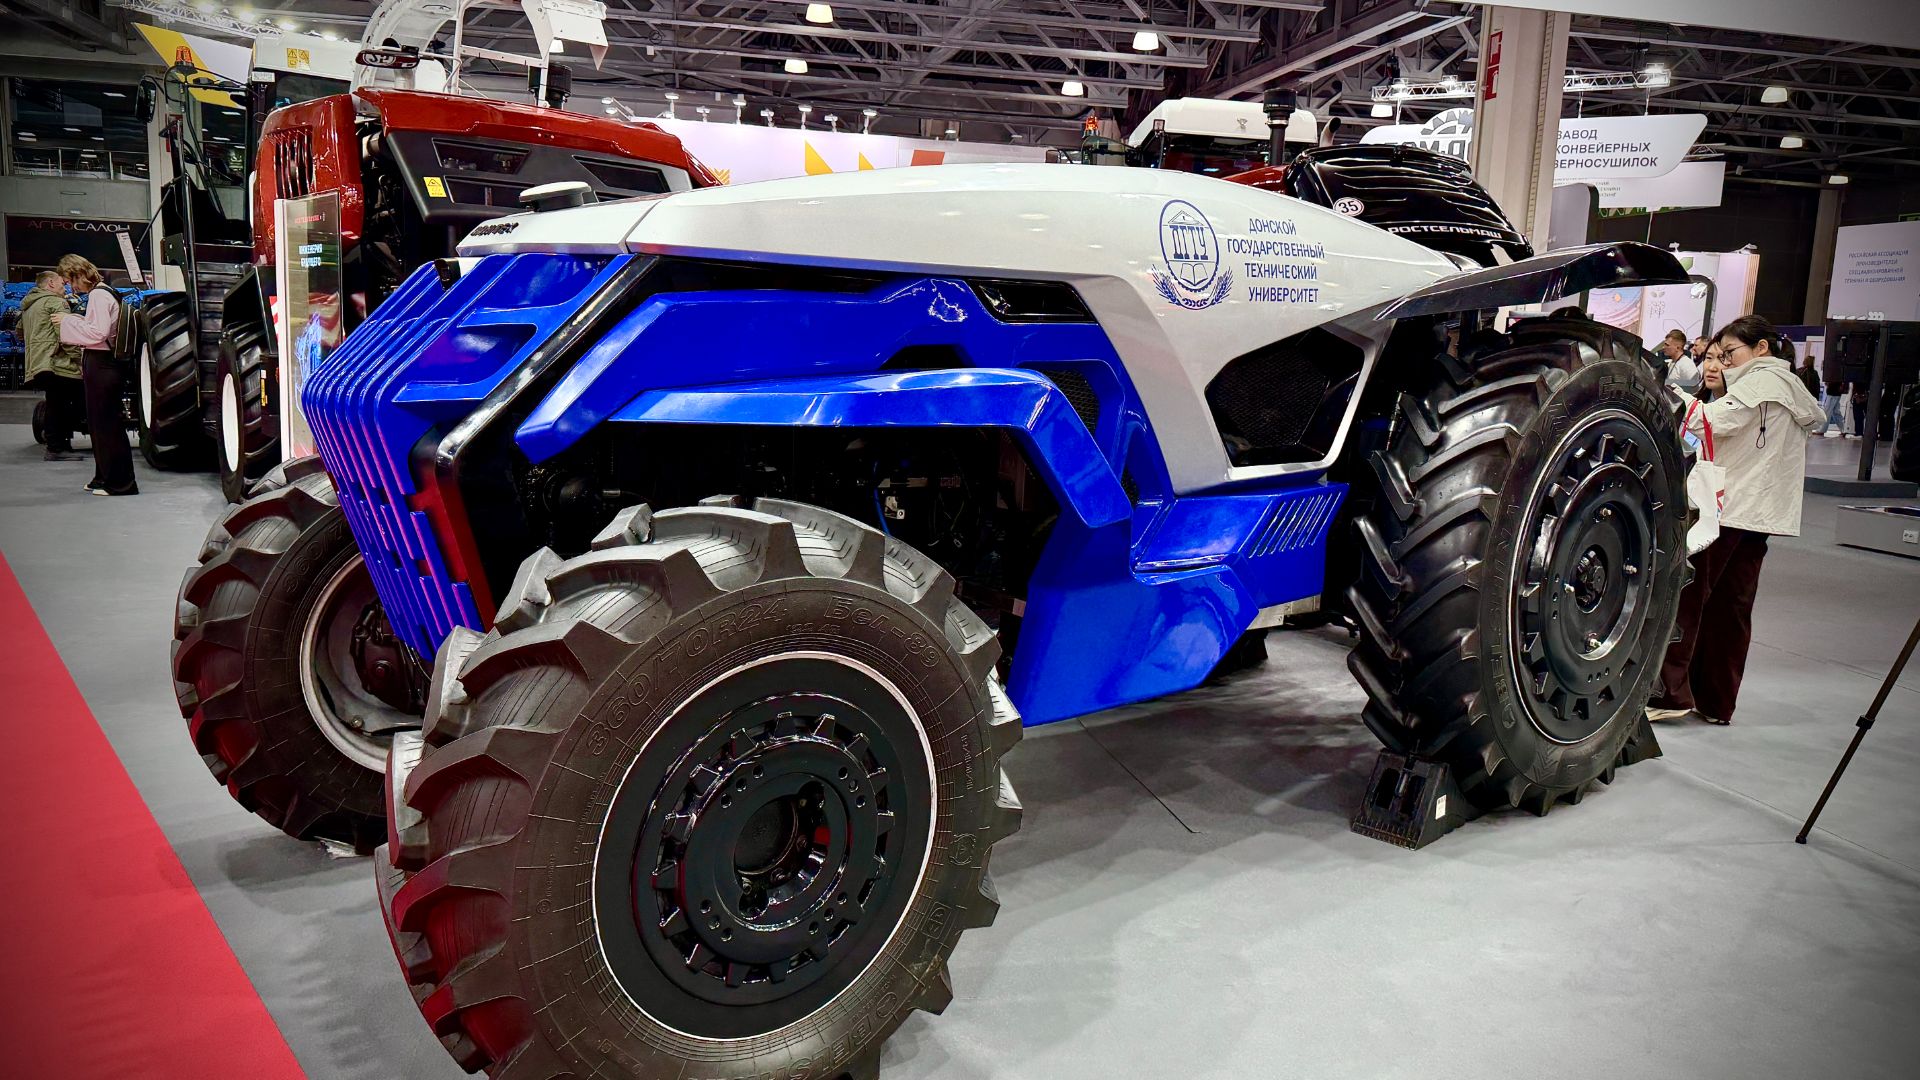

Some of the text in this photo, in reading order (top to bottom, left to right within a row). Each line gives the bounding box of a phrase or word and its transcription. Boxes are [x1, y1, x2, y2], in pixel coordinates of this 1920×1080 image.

[1556, 129, 1598, 140] ЗАВОД
[1338, 201, 1359, 214] 35
[28, 220, 131, 233] АГРОСАЛОН
[1249, 218, 1297, 235] ДОНСКОЙ
[1169, 225, 1209, 260] ДГТУ
[1227, 238, 1326, 259] ГОСУДАРСТВЕННЫЙ
[1245, 262, 1318, 280] ТЕХНИЧЕСКИЙ
[1249, 286, 1319, 303] УНИВЕРСИТЕТ
[586, 597, 787, 755] 360/70R24
